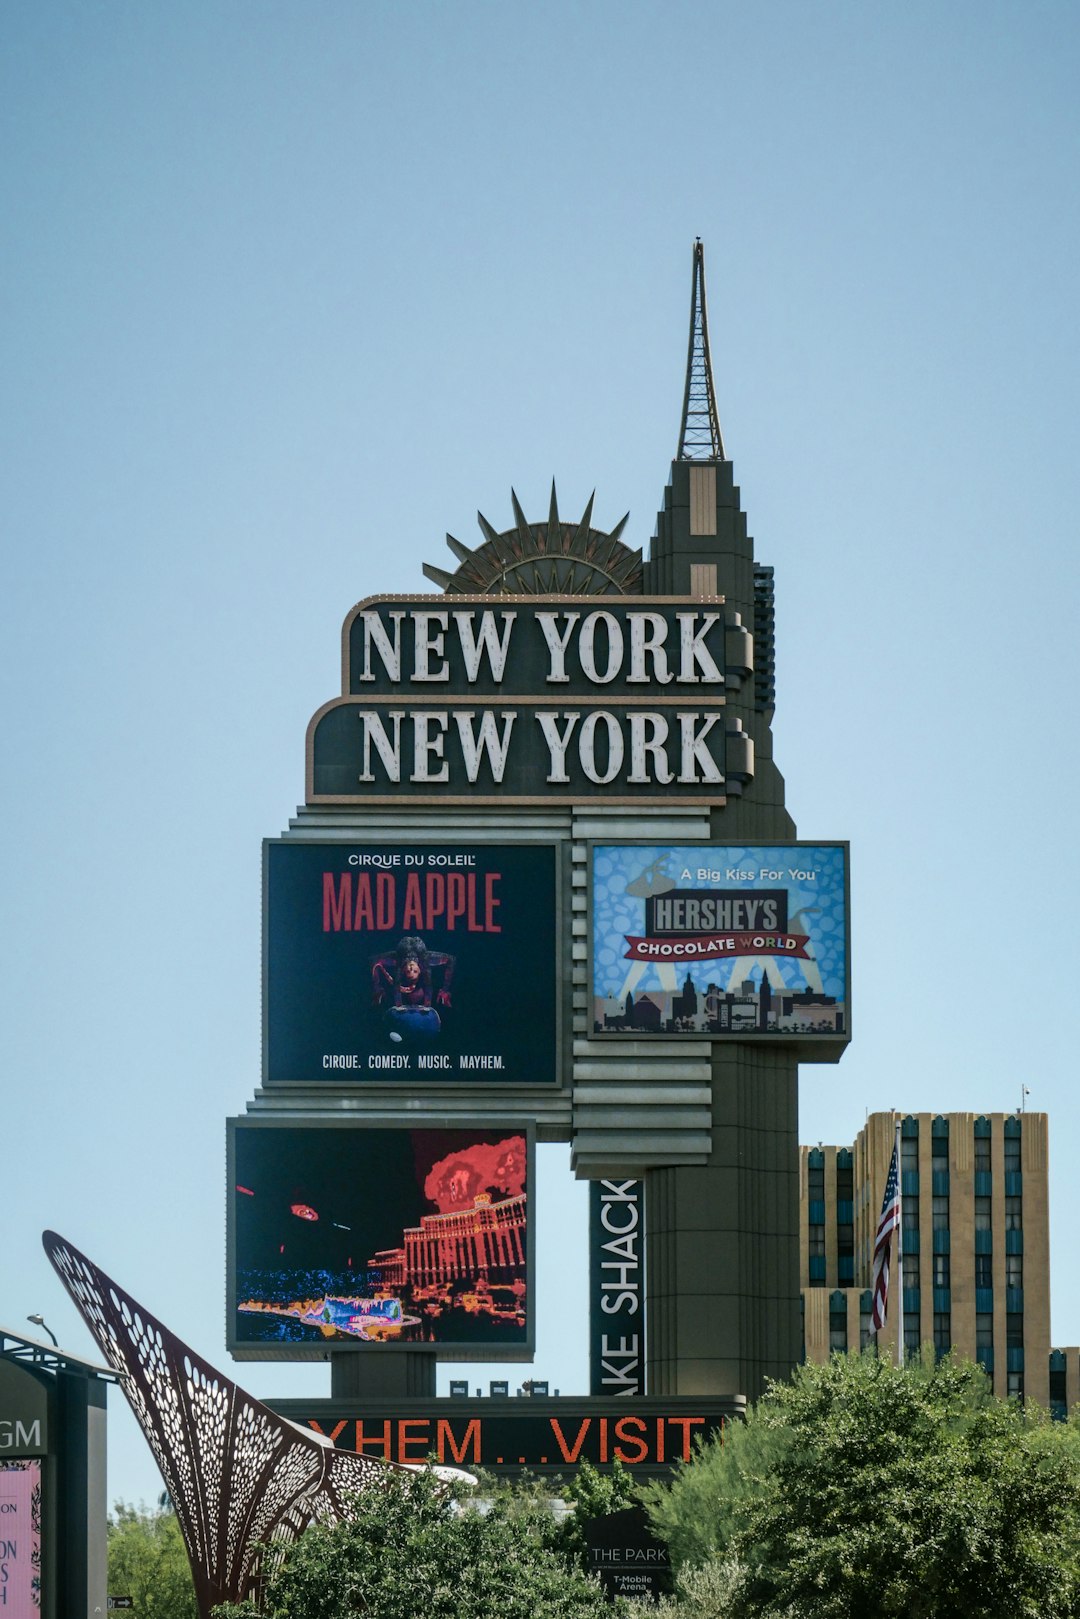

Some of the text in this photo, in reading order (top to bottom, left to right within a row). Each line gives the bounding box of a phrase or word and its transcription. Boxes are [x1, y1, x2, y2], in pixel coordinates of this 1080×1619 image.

[359, 610, 725, 684] NEW YORK
[359, 710, 725, 785] NEW YORK
[348, 854, 401, 868] CIRQUE
[405, 854, 424, 866] DU
[681, 868, 692, 880] A
[697, 868, 721, 882] Big
[726, 868, 755, 881] Kiss
[760, 868, 783, 881] For
[322, 871, 502, 933] MAD APPLE
[656, 899, 778, 930] HERSHEY'S
[636, 936, 797, 955] CHOCOLATE WORLD
[322, 1055, 505, 1069] CIRQUE. COMEDY. MUSIC. MAYHEM.
[600, 1180, 639, 1315] SHACK
[592, 1548, 667, 1561] THE PARK
[613, 1575, 652, 1583] T-Mobile
